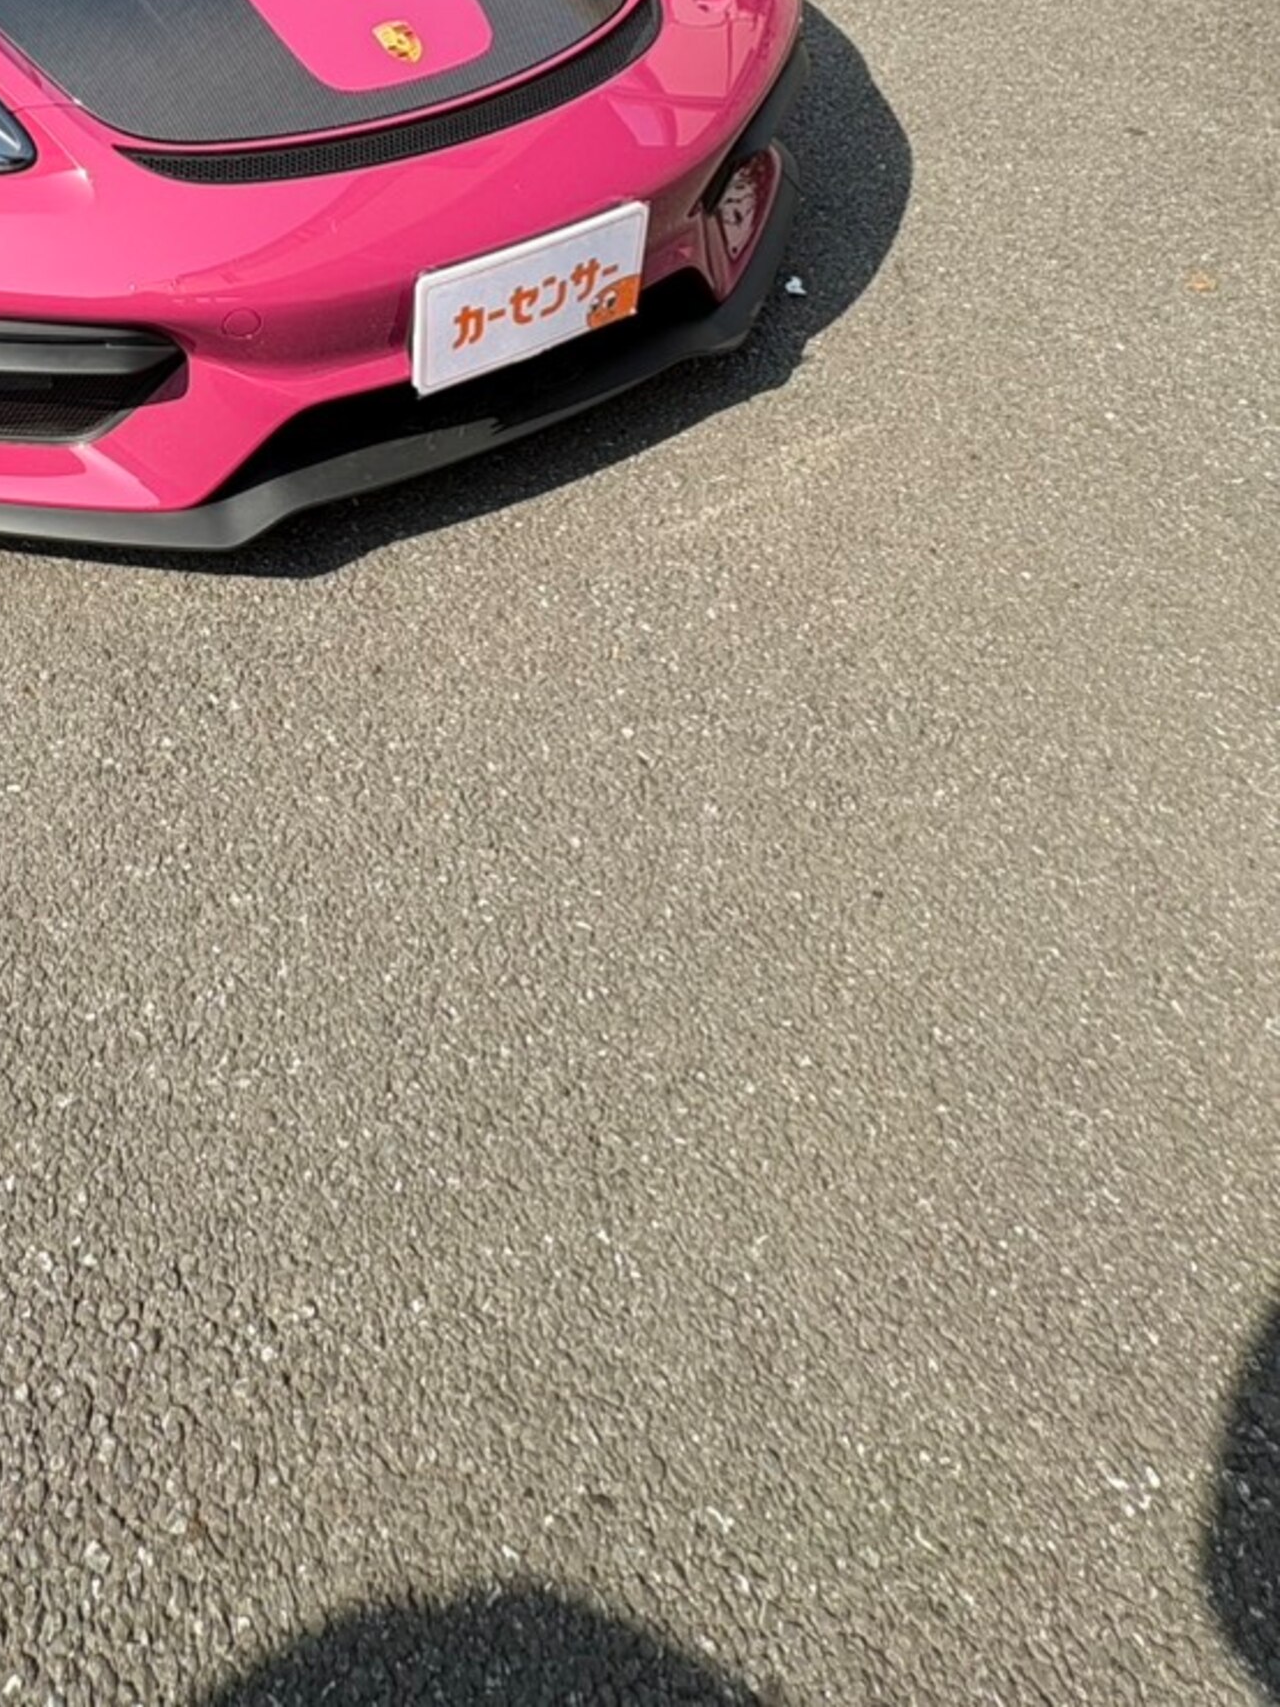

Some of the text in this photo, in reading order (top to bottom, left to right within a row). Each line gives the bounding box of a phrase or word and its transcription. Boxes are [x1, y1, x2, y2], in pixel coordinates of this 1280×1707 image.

[452, 257, 618, 350] カーセンサー
